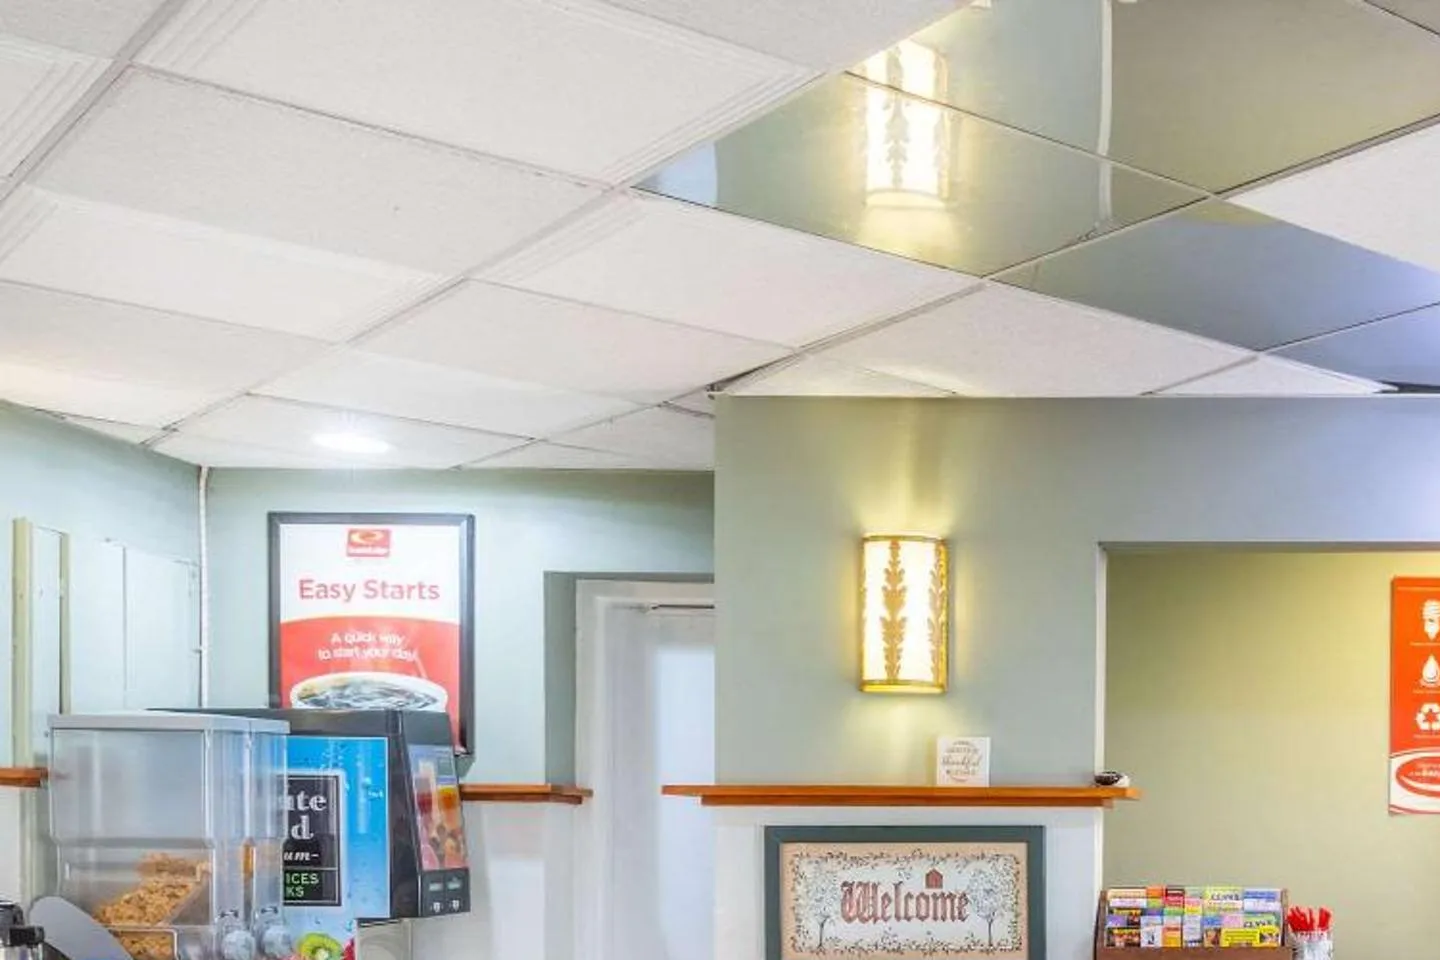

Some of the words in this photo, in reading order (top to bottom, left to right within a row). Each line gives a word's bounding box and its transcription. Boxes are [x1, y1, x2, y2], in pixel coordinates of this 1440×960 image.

[299, 579, 357, 603] Easy
[363, 579, 440, 600] Starts
[331, 632, 342, 645] A
[344, 630, 375, 647] quick
[318, 648, 332, 661] to
[840, 879, 971, 925] Welcome
